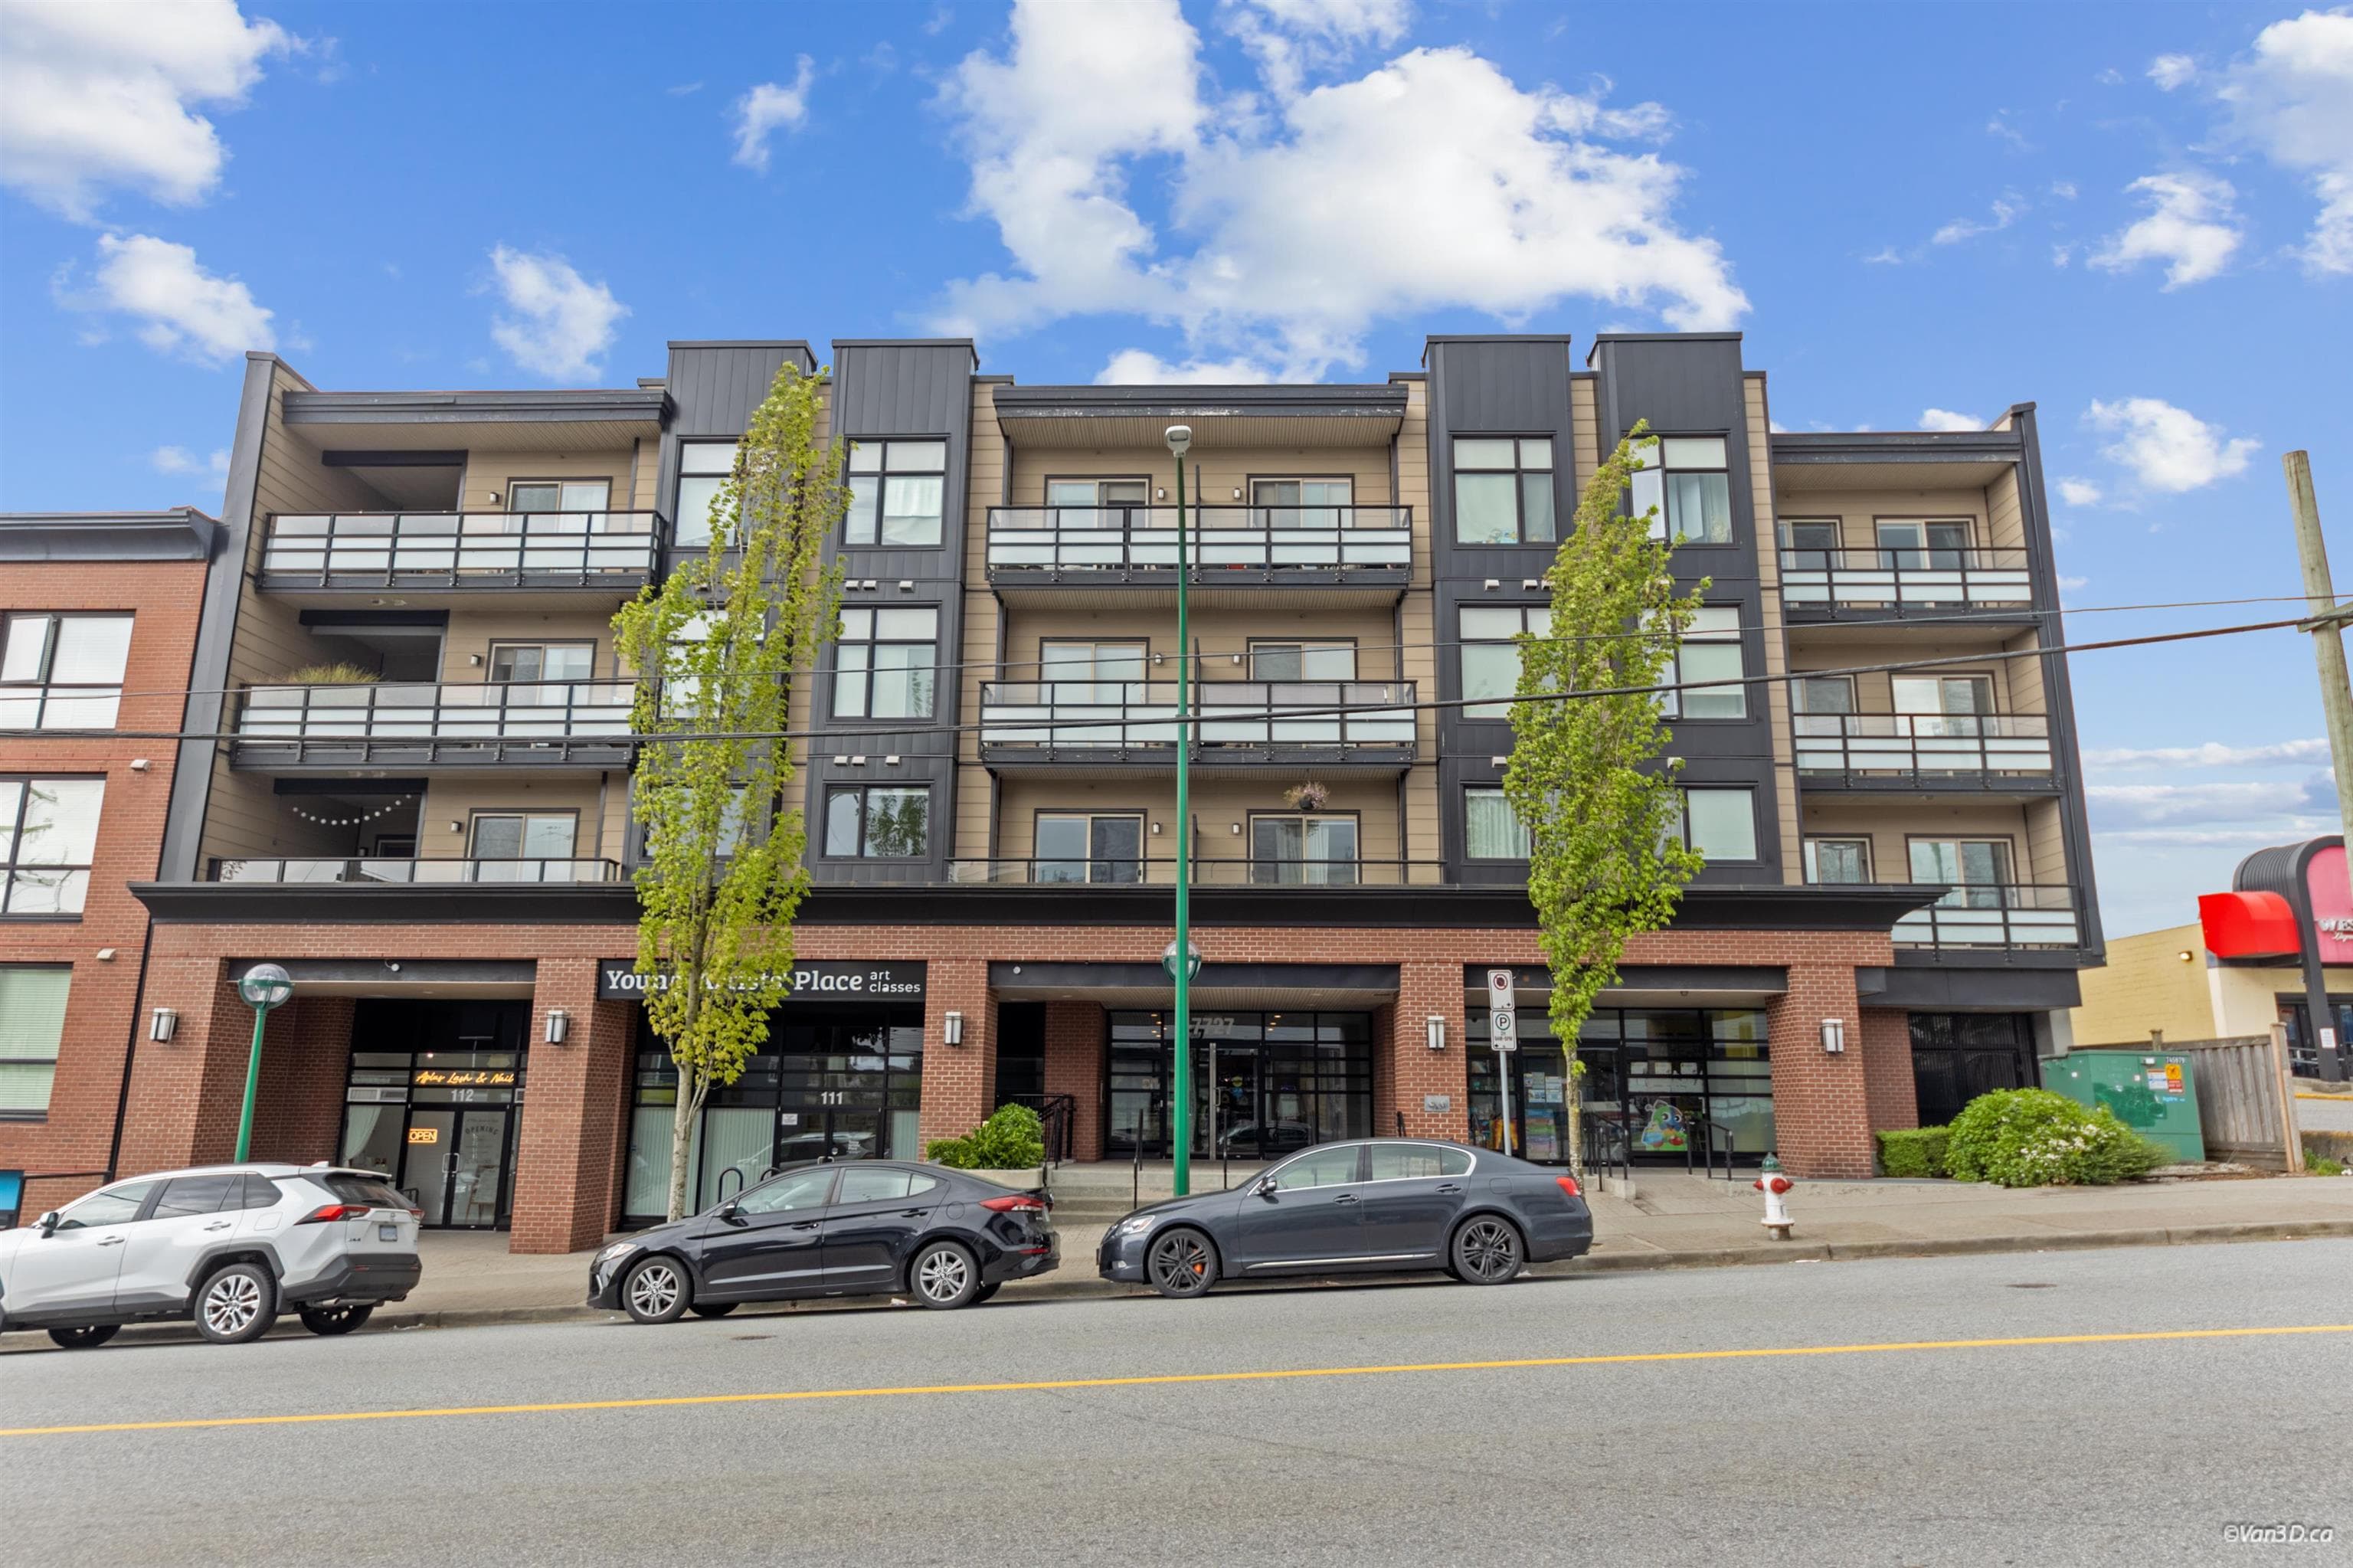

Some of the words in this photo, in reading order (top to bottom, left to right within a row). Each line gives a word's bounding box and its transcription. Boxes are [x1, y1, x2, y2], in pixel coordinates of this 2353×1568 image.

[869, 970, 890, 980] art
[606, 970, 682, 994] Youn
[794, 970, 862, 990] Place
[869, 982, 921, 993] classes
[1191, 1016, 1235, 1035] 7727
[447, 1072, 473, 1083] Lash
[475, 1072, 489, 1083] &
[490, 1072, 515, 1083] Nail
[450, 1088, 474, 1102] 112
[820, 1091, 843, 1105] 111
[409, 1131, 435, 1141] OPEN
